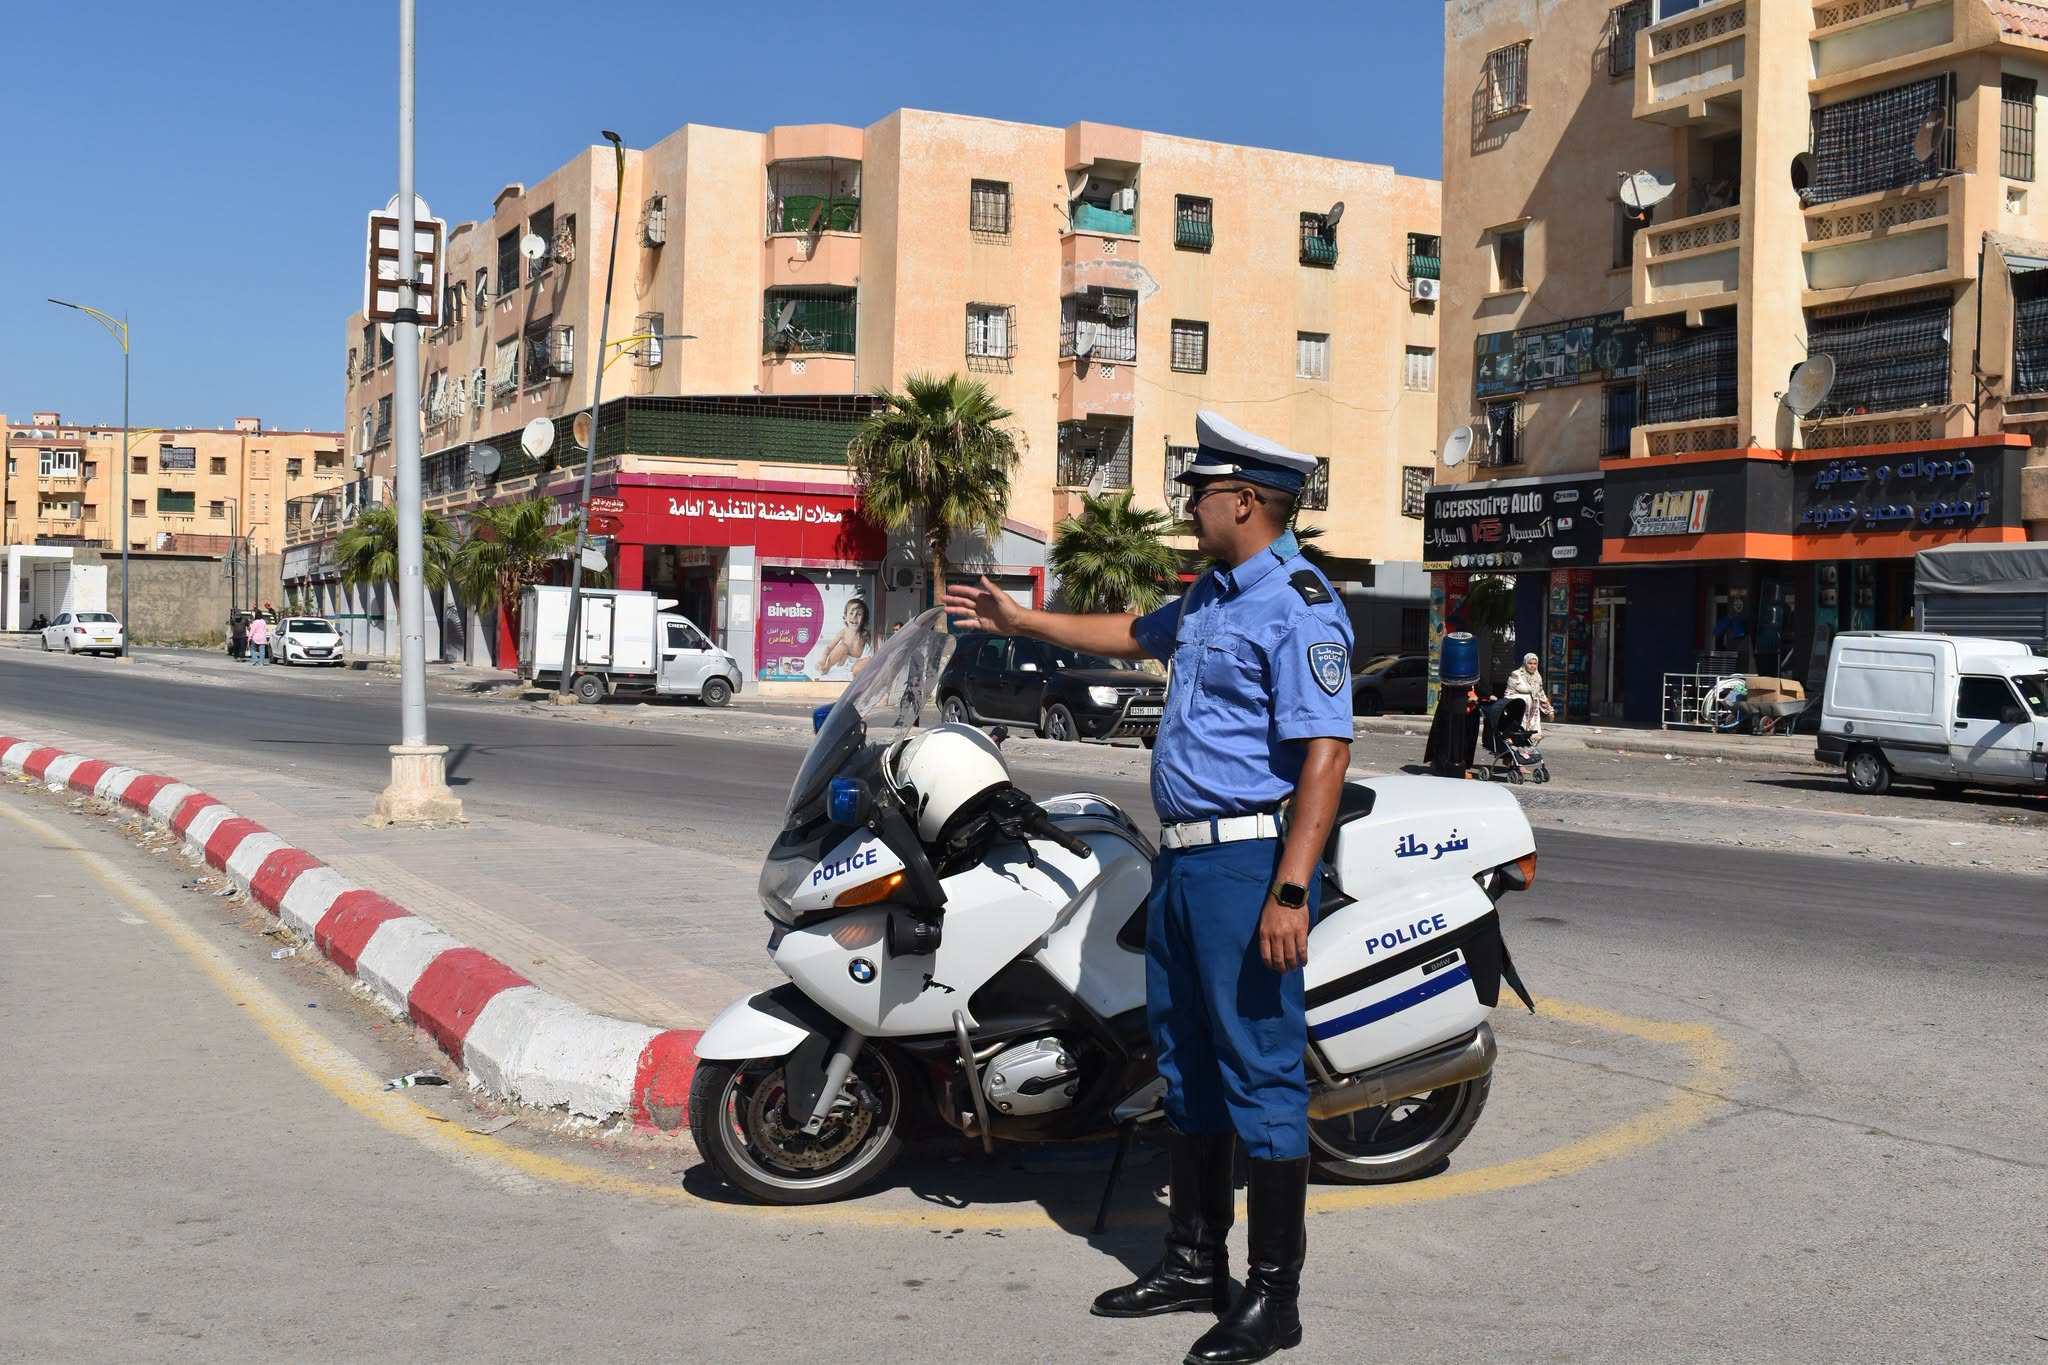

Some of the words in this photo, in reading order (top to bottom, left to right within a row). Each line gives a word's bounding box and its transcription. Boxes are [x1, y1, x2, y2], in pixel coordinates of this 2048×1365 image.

[1815, 460, 1871, 490] عقاقير
[1876, 464, 1890, 485] و
[1898, 451, 1975, 481] خردوات
[668, 497, 704, 517] العامة
[707, 498, 756, 523] للتغذية
[757, 502, 803, 523] الحضنة
[804, 504, 843, 524] محلات
[1434, 496, 1508, 519] Accessoire
[1511, 493, 1543, 514] Auto
[1863, 503, 1915, 529] صحي
[1920, 491, 1991, 525] ترصيص
[1424, 526, 1467, 548] السيارات
[667, 622, 688, 630] CHERY
[1318, 654, 1342, 663] POLICE
[1394, 828, 1469, 860] شرطة
[812, 848, 878, 887] POLICE
[1365, 913, 1448, 955] POLICE
[1430, 957, 1452, 971] BMW
